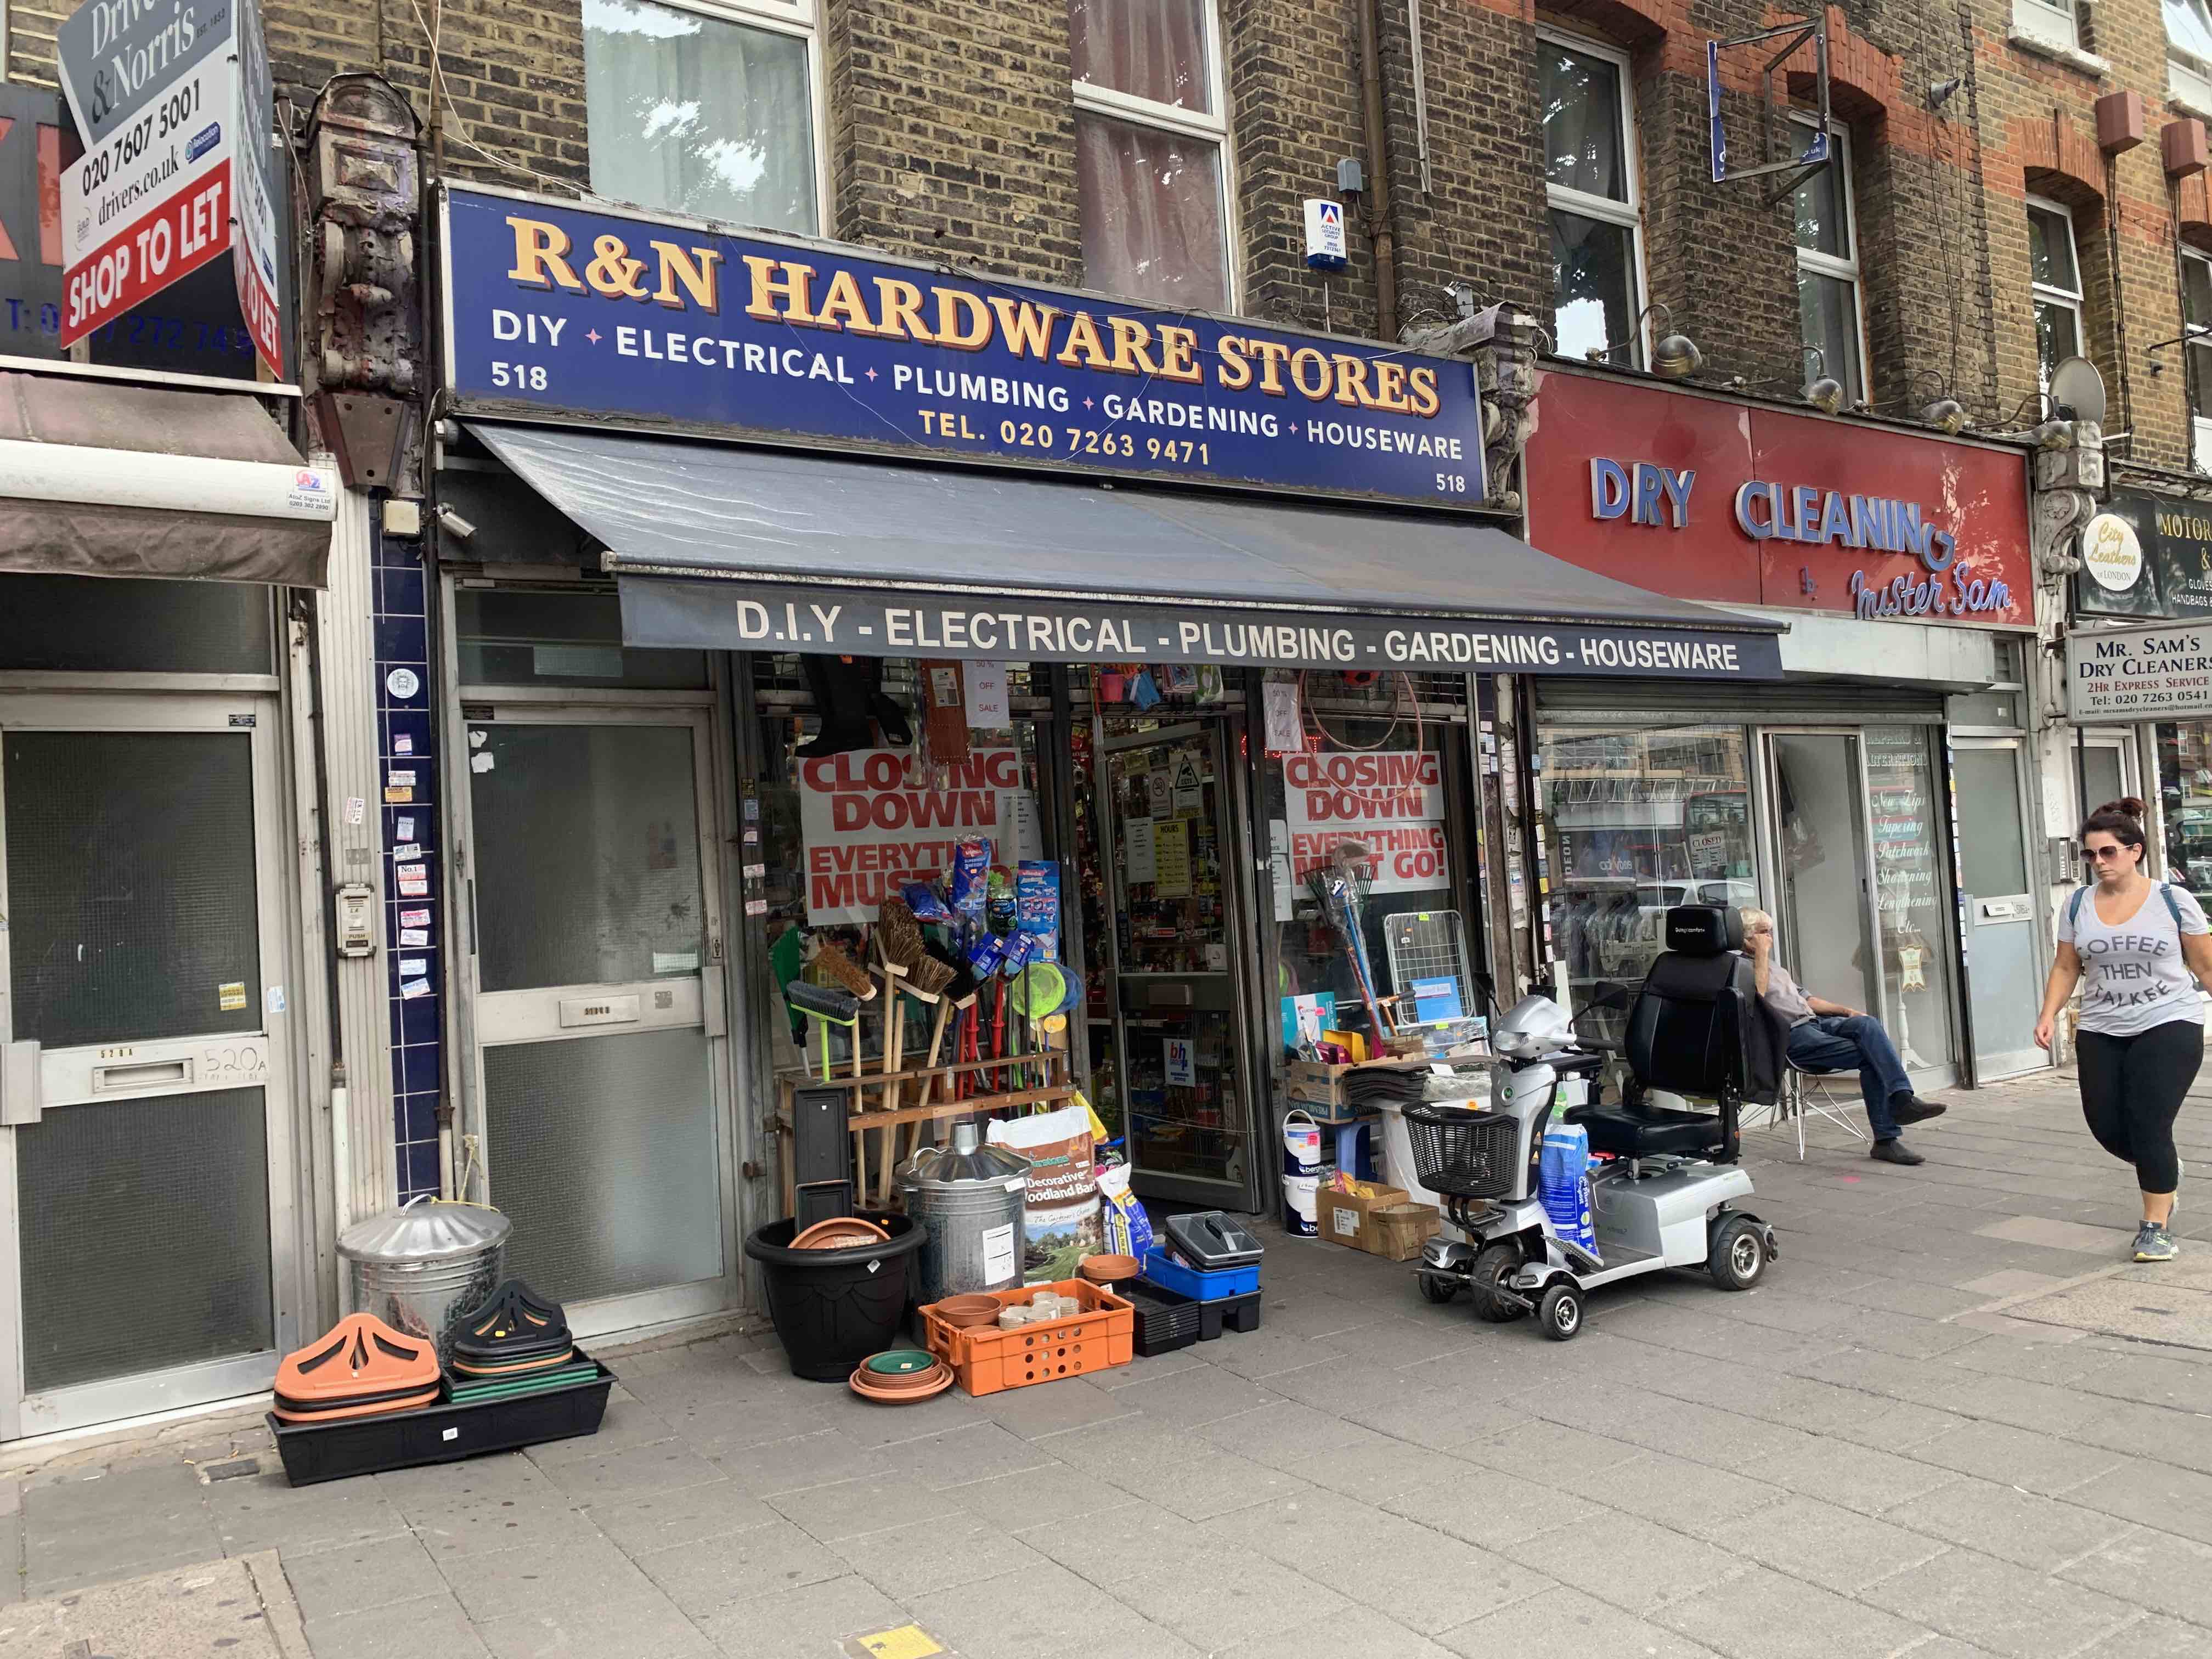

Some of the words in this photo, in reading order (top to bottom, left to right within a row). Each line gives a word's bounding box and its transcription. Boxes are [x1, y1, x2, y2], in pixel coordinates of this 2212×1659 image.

[111, 1, 195, 109] Norris
[83, 149, 109, 196] 020
[114, 116, 153, 172] 7607
[159, 77, 200, 139] 5001
[99, 144, 179, 225] drivers.co.uk
[69, 244, 130, 328] SHOP
[137, 217, 171, 284] TO
[180, 180, 223, 260] LET
[260, 291, 278, 360] LET
[505, 216, 722, 315] R&N
[742, 254, 1203, 384] HARDWARE
[1217, 335, 1440, 419] STORES
[492, 308, 567, 347] DIY
[616, 325, 854, 385] ELECTRICAL
[893, 364, 1069, 413] PLUMBING
[1103, 394, 1279, 436] GARDENING
[1307, 419, 1463, 460] HOUSEWARE
[492, 362, 548, 391] 518
[918, 409, 986, 442] TEL.
[1000, 420, 1054, 449] 020
[1066, 427, 1135, 458] 7263
[1147, 436, 1208, 465] 9471
[1435, 472, 1466, 493] 518
[1590, 457, 1696, 528] DRY
[1735, 480, 1956, 572] CLEANING
[2097, 521, 2125, 545] City
[2088, 545, 2136, 567] Leathers
[2201, 547, 2211, 570] &
[1951, 561, 2012, 616] Sam
[2104, 569, 2131, 582] LONDON
[2172, 594, 2208, 607] HANDBAGS
[736, 600, 841, 642] D.I.Y
[885, 608, 1146, 653] ELECTRICAL
[1178, 620, 1355, 662] PLUMBING
[1385, 630, 1559, 666] GARDENING
[1582, 637, 1740, 671] HOUSEWARE
[979, 681, 995, 690] OFF
[2079, 662, 2115, 679] DRY
[2114, 680, 2159, 692] EXPRESS
[2165, 676, 2209, 688] SERVICE
[978, 703, 999, 712] SALE
[2090, 696, 2111, 707] Tel:
[2115, 693, 2137, 704] 020
[2143, 692, 2172, 703] 7263
[2177, 690, 2208, 701] 0541
[803, 751, 1019, 792] CLONG
[1285, 754, 1439, 789] CLOSING
[832, 790, 996, 831] DOWN
[1305, 787, 1424, 822] DOWN
[1160, 823, 1180, 834] HOURS
[1692, 835, 1722, 848] CLOSED
[809, 838, 1001, 873] EVERYTN
[1293, 854, 1384, 887] MT
[1393, 850, 1445, 878] GO!
[2098, 961, 2153, 980] THEN
[2095, 980, 2170, 1007] TALKEE
[1026, 1170, 1086, 1188] Decorative
